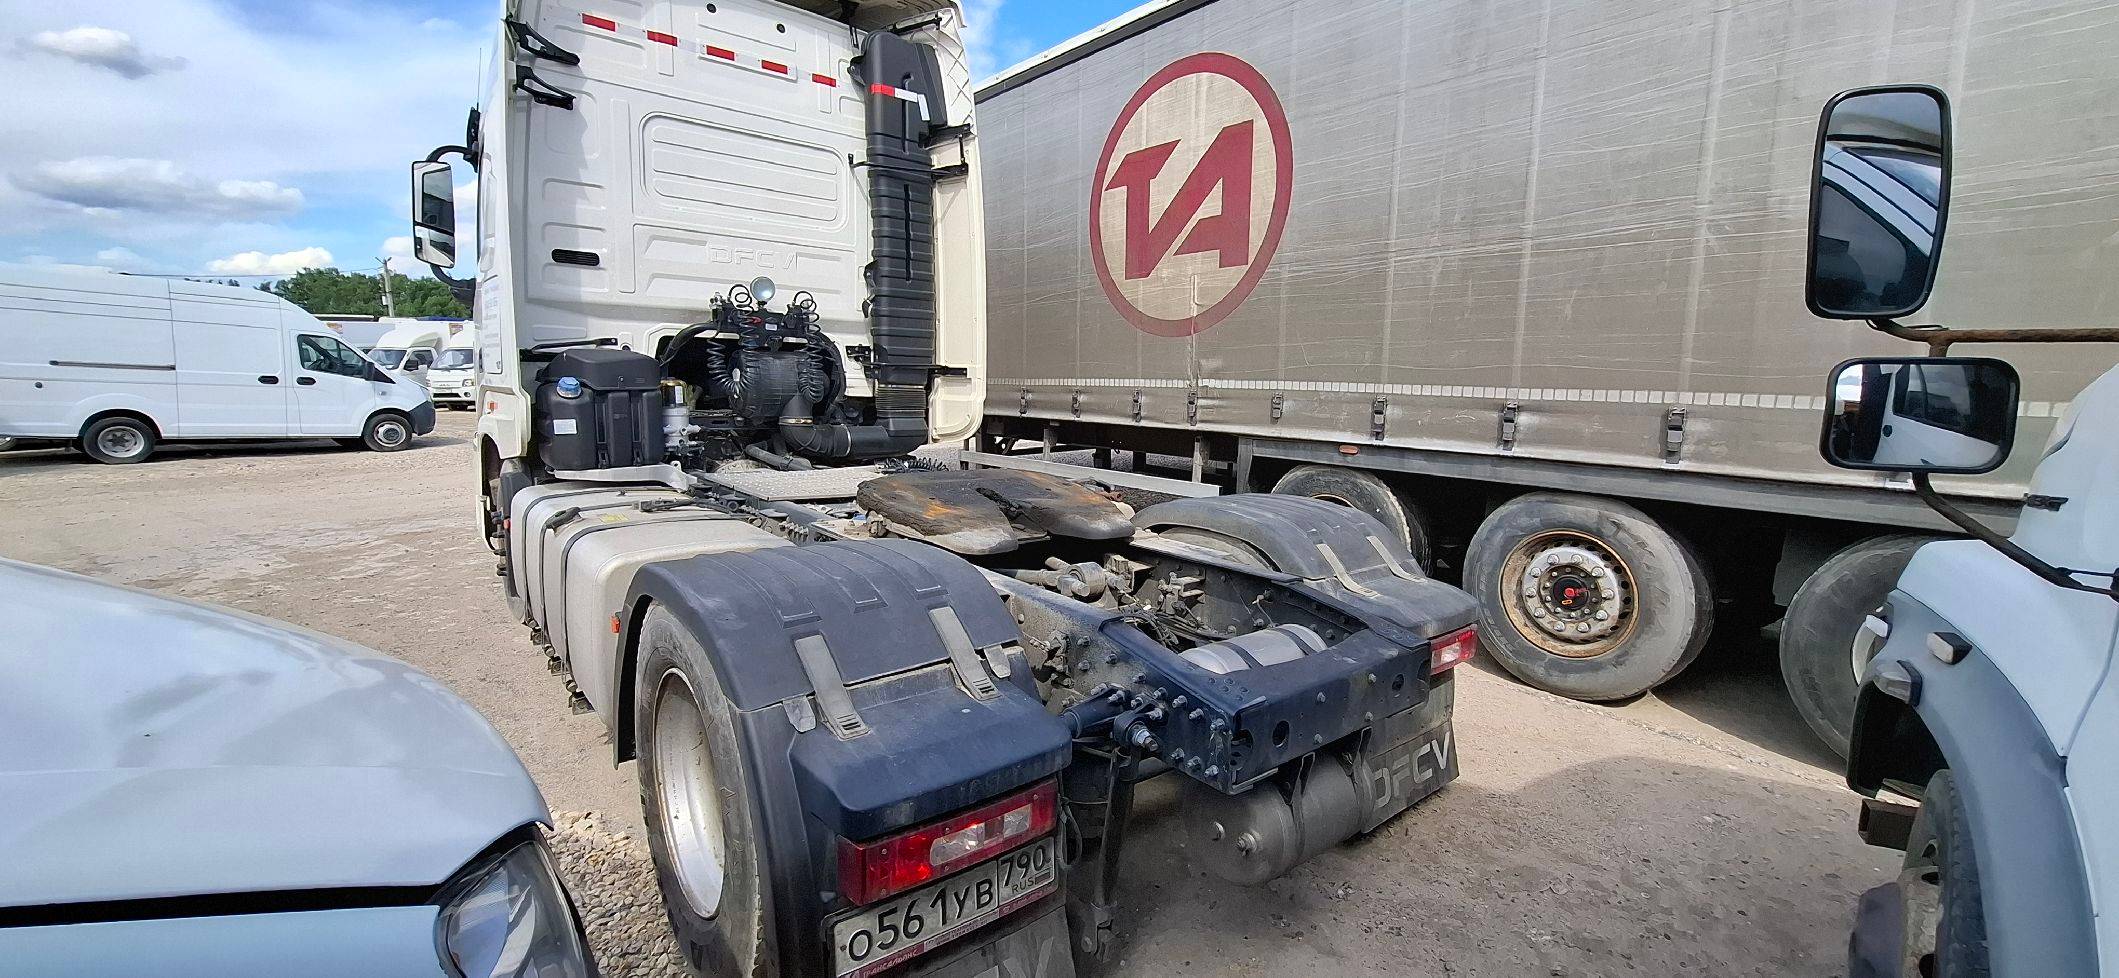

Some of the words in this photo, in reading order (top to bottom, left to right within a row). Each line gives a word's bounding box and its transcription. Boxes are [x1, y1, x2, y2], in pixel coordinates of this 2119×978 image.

[1373, 731, 1451, 808] DFCV
[1000, 844, 1046, 887] 790
[1011, 876, 1035, 894] RUS
